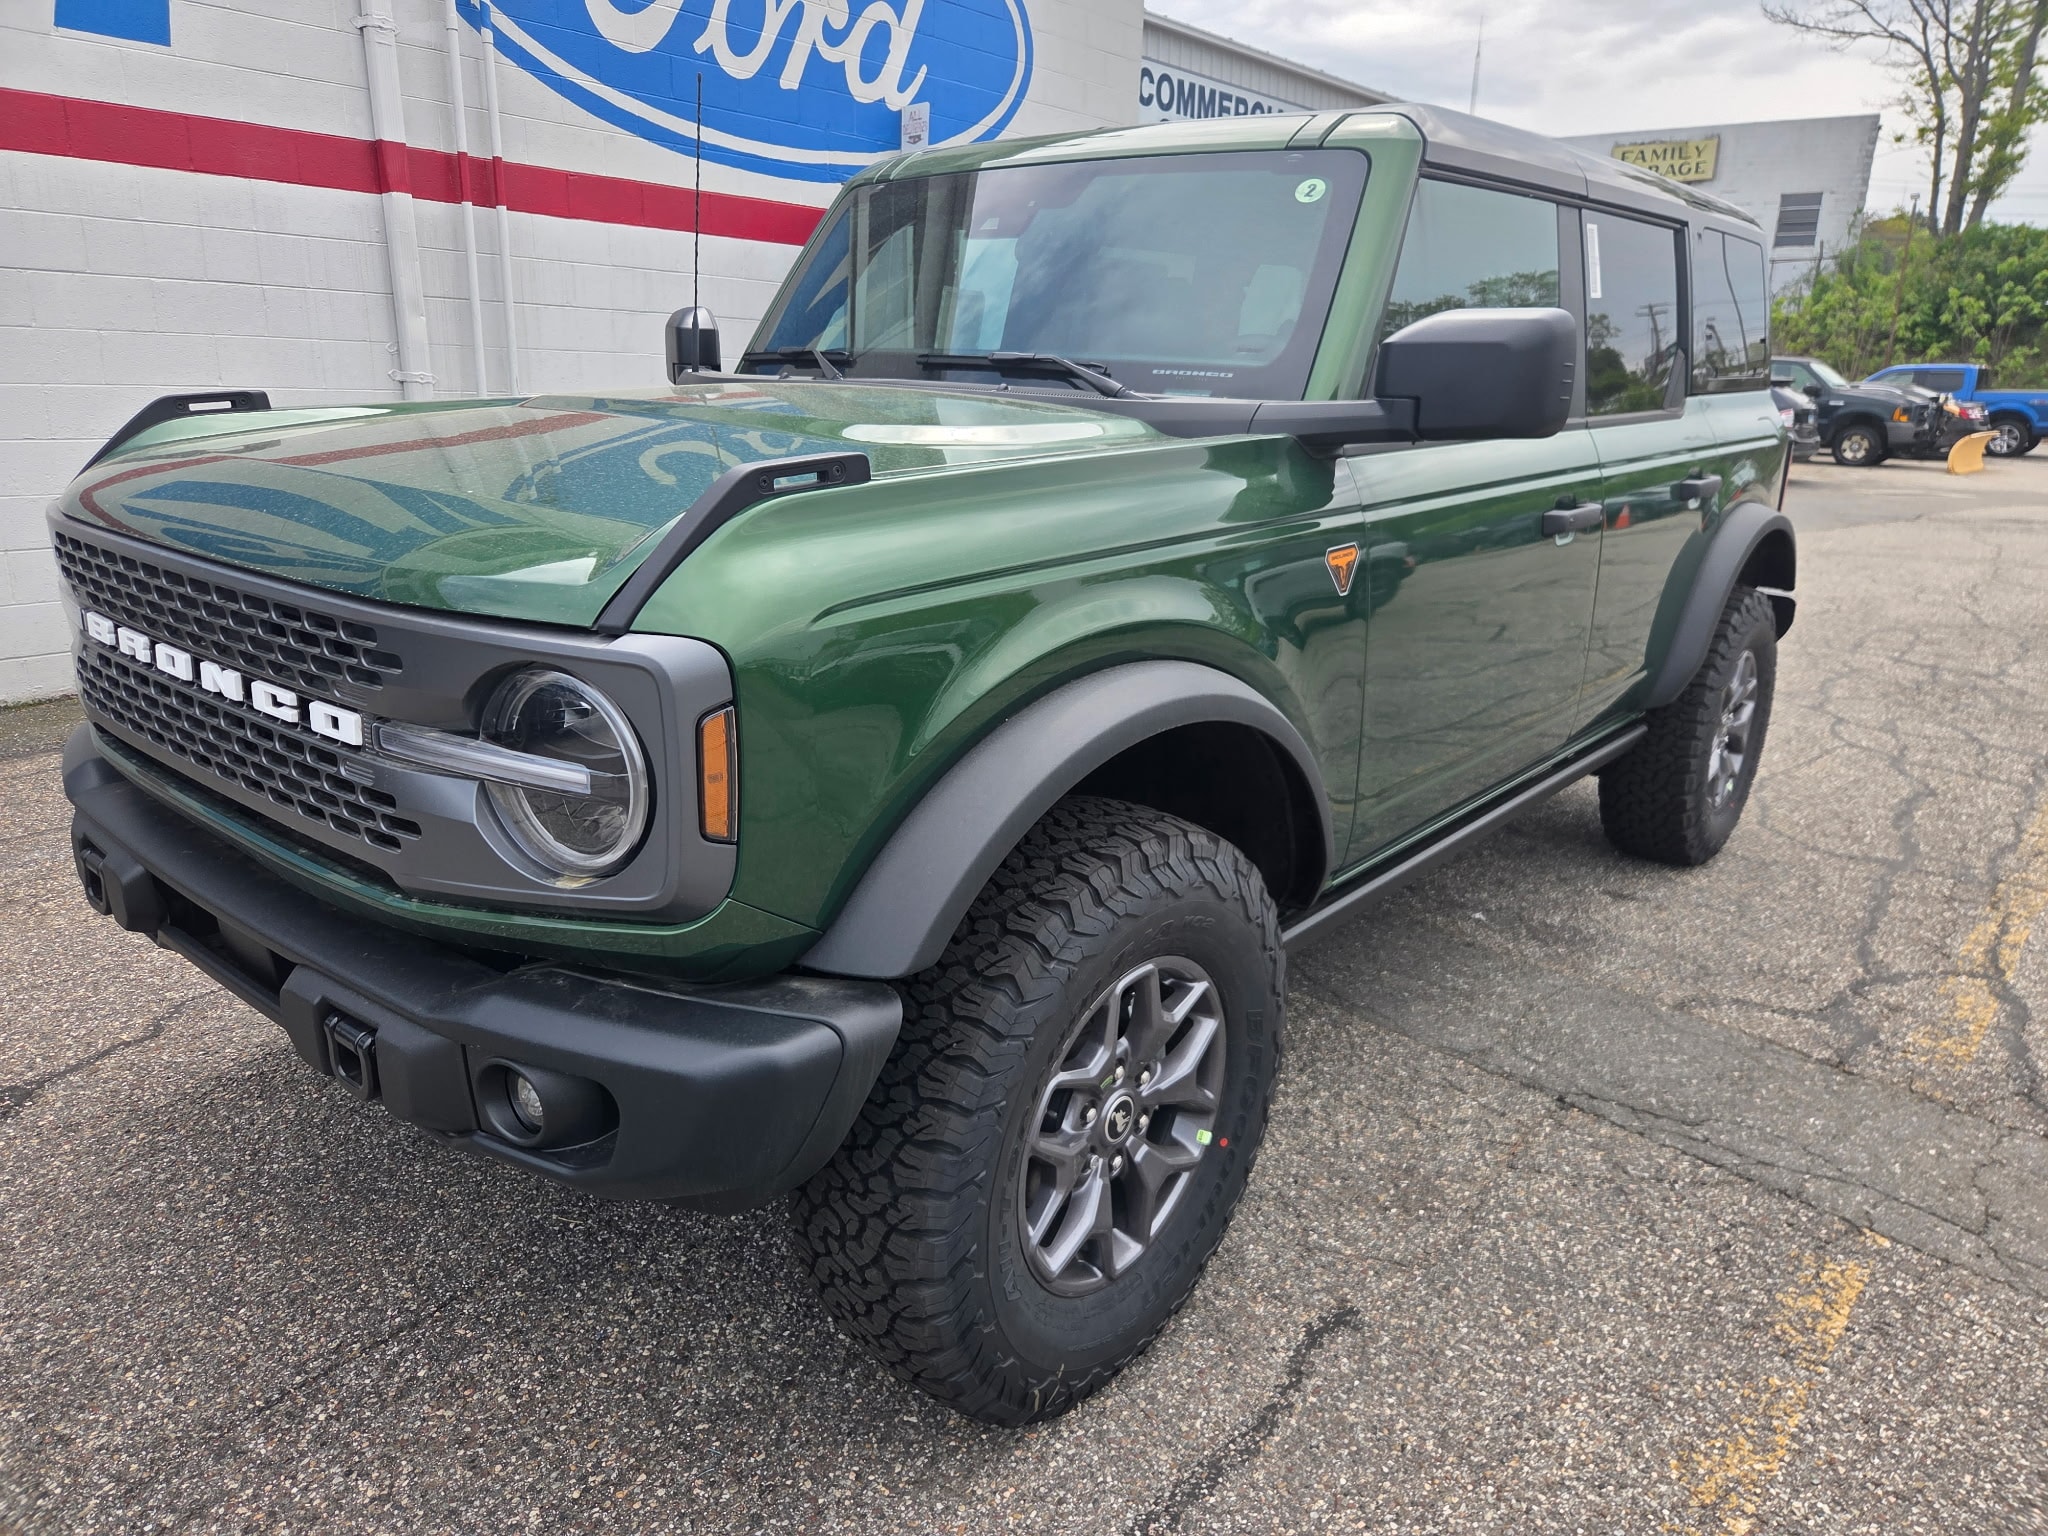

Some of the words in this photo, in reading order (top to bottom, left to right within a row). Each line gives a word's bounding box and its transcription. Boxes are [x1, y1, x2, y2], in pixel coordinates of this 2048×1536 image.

[1139, 67, 1284, 119] COMMER
[1621, 145, 1707, 163] FAMILY
[1647, 161, 1706, 176] RAGE
[1304, 184, 1317, 197] 2
[1152, 369, 1233, 378] BRONCO
[86, 611, 362, 746] BRONCO
